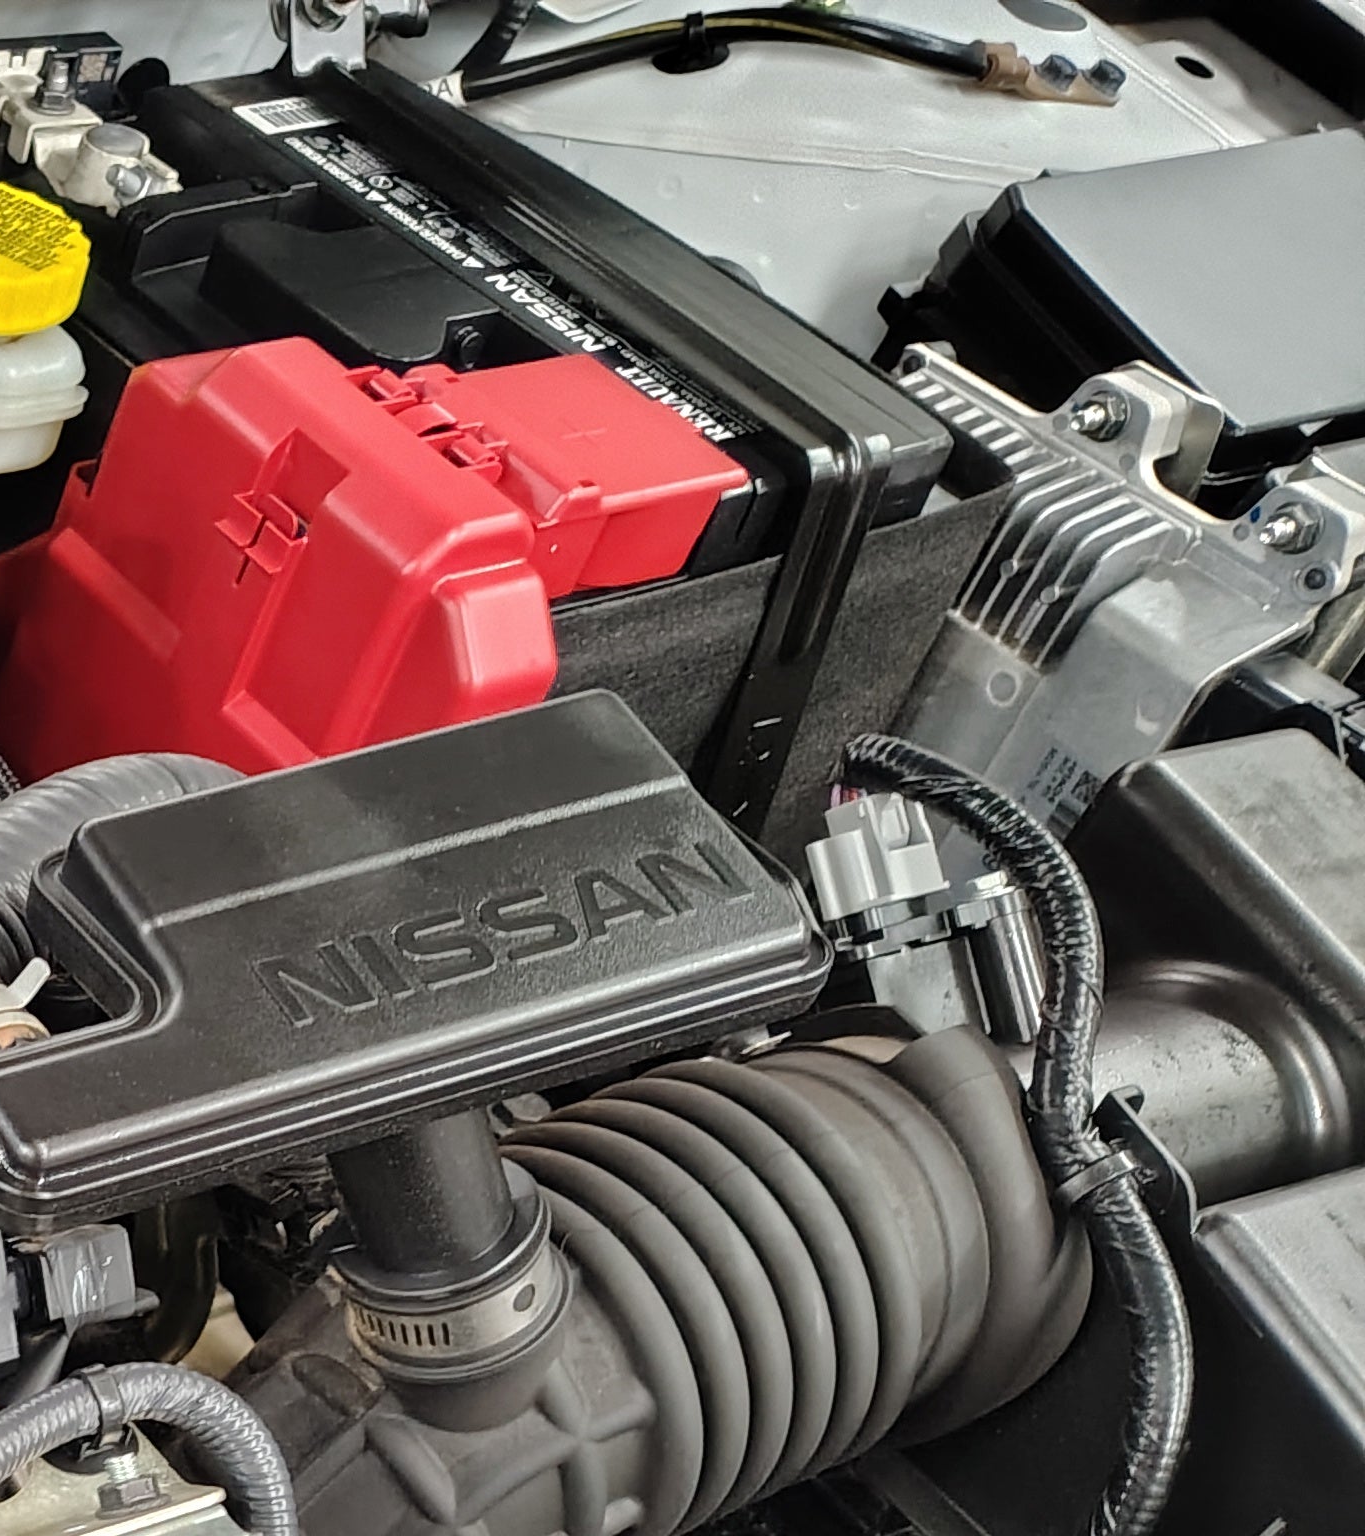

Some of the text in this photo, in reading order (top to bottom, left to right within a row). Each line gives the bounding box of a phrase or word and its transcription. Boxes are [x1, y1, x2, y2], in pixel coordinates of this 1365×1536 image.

[484, 273, 606, 353] NISSAN
[615, 365, 736, 443] RENAULT
[250, 841, 755, 1028] NISSAN
